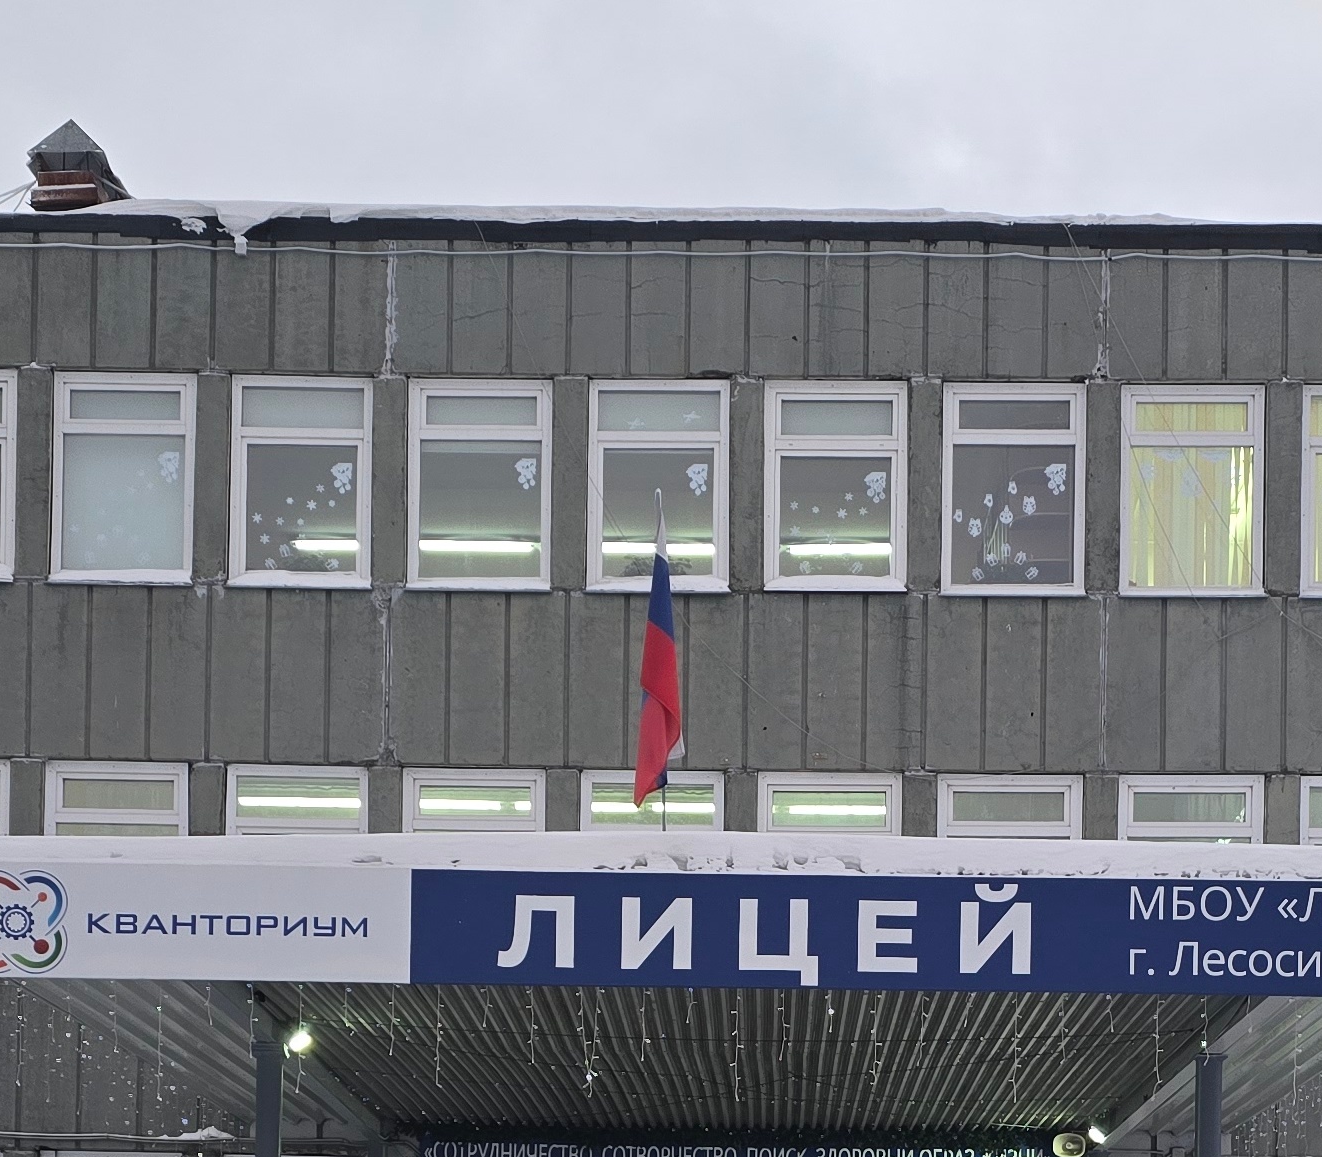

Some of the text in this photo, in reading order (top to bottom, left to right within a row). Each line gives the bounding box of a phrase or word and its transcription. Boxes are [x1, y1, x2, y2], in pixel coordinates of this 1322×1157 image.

[1128, 885, 1266, 921] МБОУ
[86, 912, 369, 938] КВАНТОРИУМ
[497, 883, 1032, 987] ЛИЦЕЙ
[1128, 947, 1156, 976] г.
